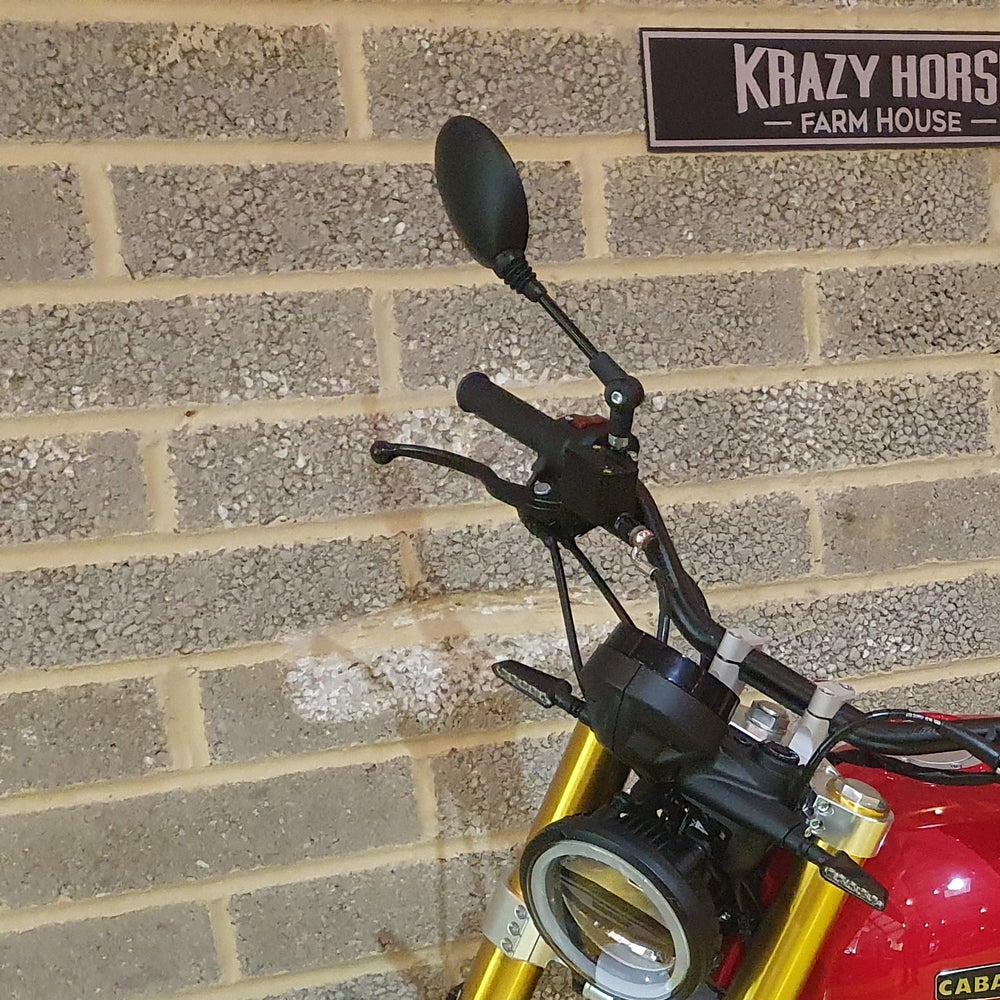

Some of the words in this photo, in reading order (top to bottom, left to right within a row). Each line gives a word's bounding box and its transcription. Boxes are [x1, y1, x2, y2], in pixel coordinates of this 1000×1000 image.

[733, 42, 879, 114] KRAZY
[801, 107, 869, 134] FARM
[875, 106, 962, 133] HOUSE
